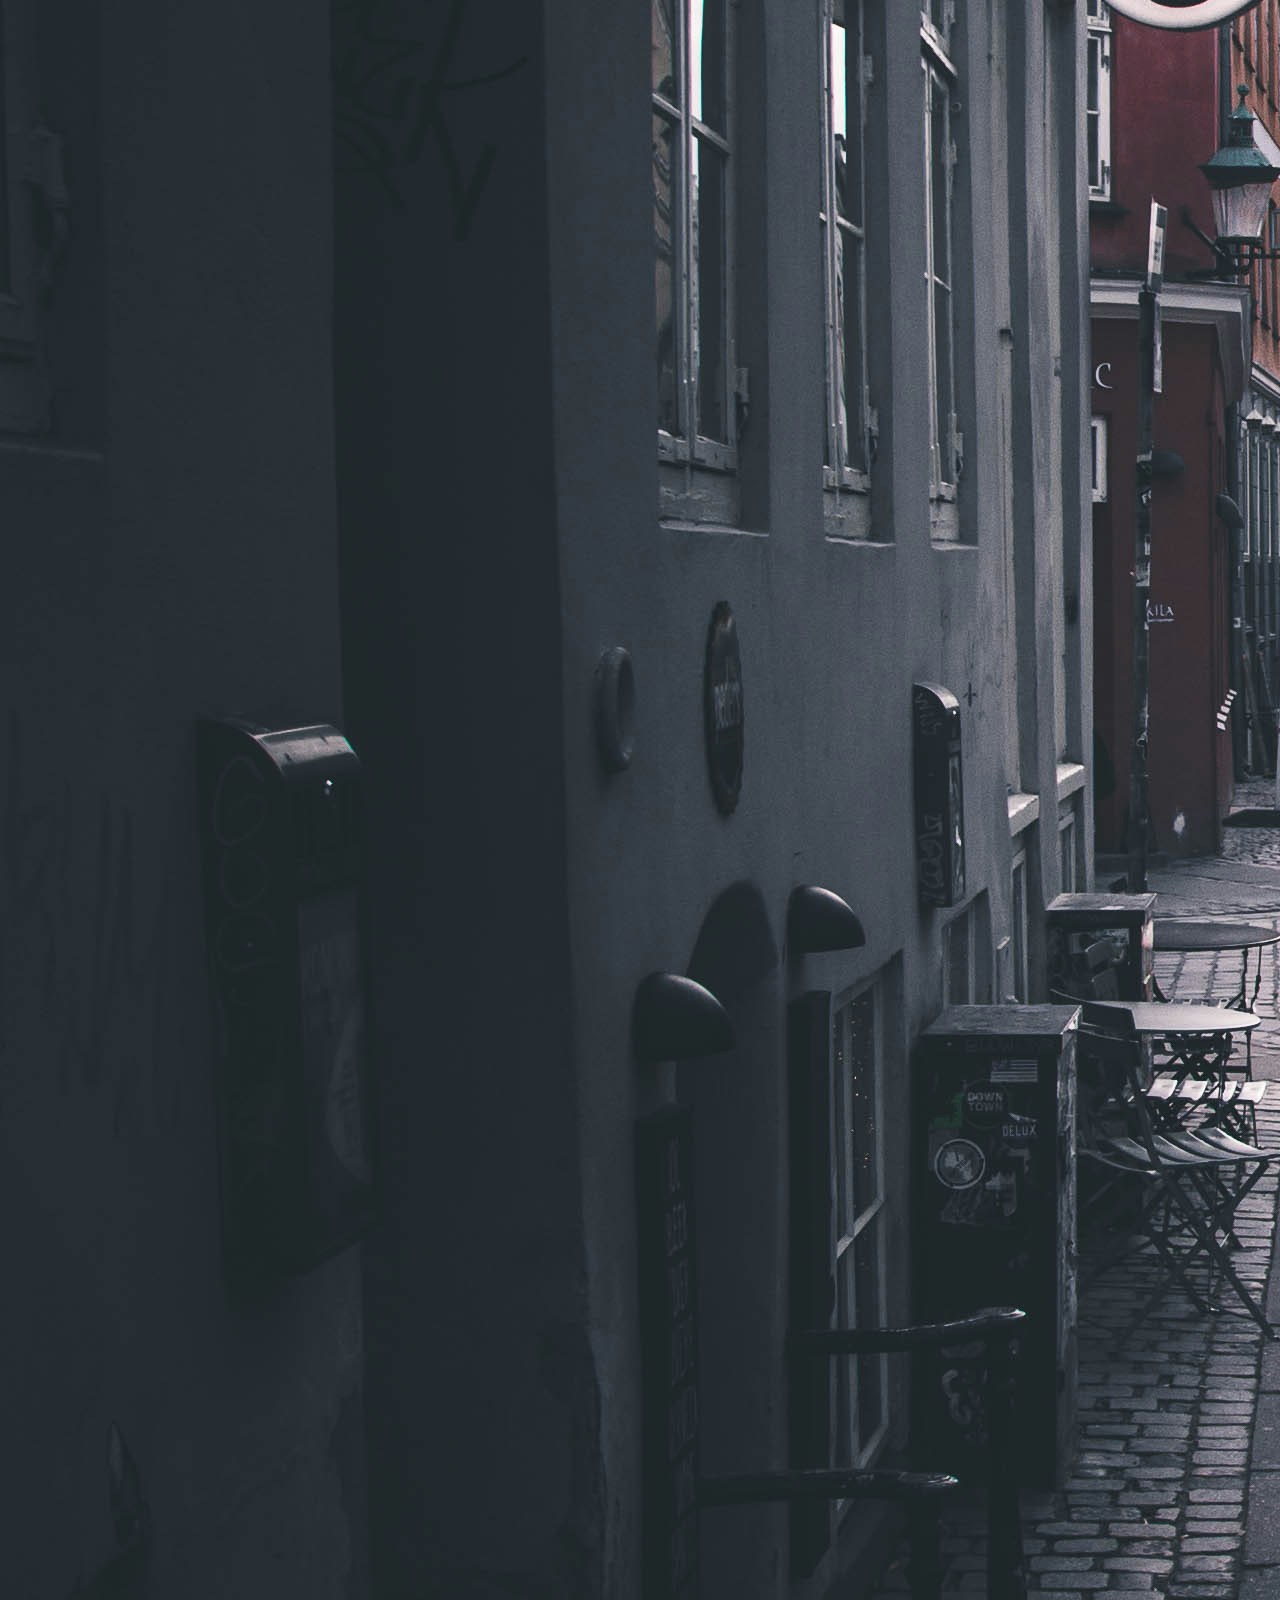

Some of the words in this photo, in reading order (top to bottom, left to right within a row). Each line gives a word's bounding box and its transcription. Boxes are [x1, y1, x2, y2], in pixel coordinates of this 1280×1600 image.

[967, 1092, 1003, 1103] DOWN
[967, 1102, 1003, 1113] TOWN
[1001, 1124, 1037, 1138] DELUX
